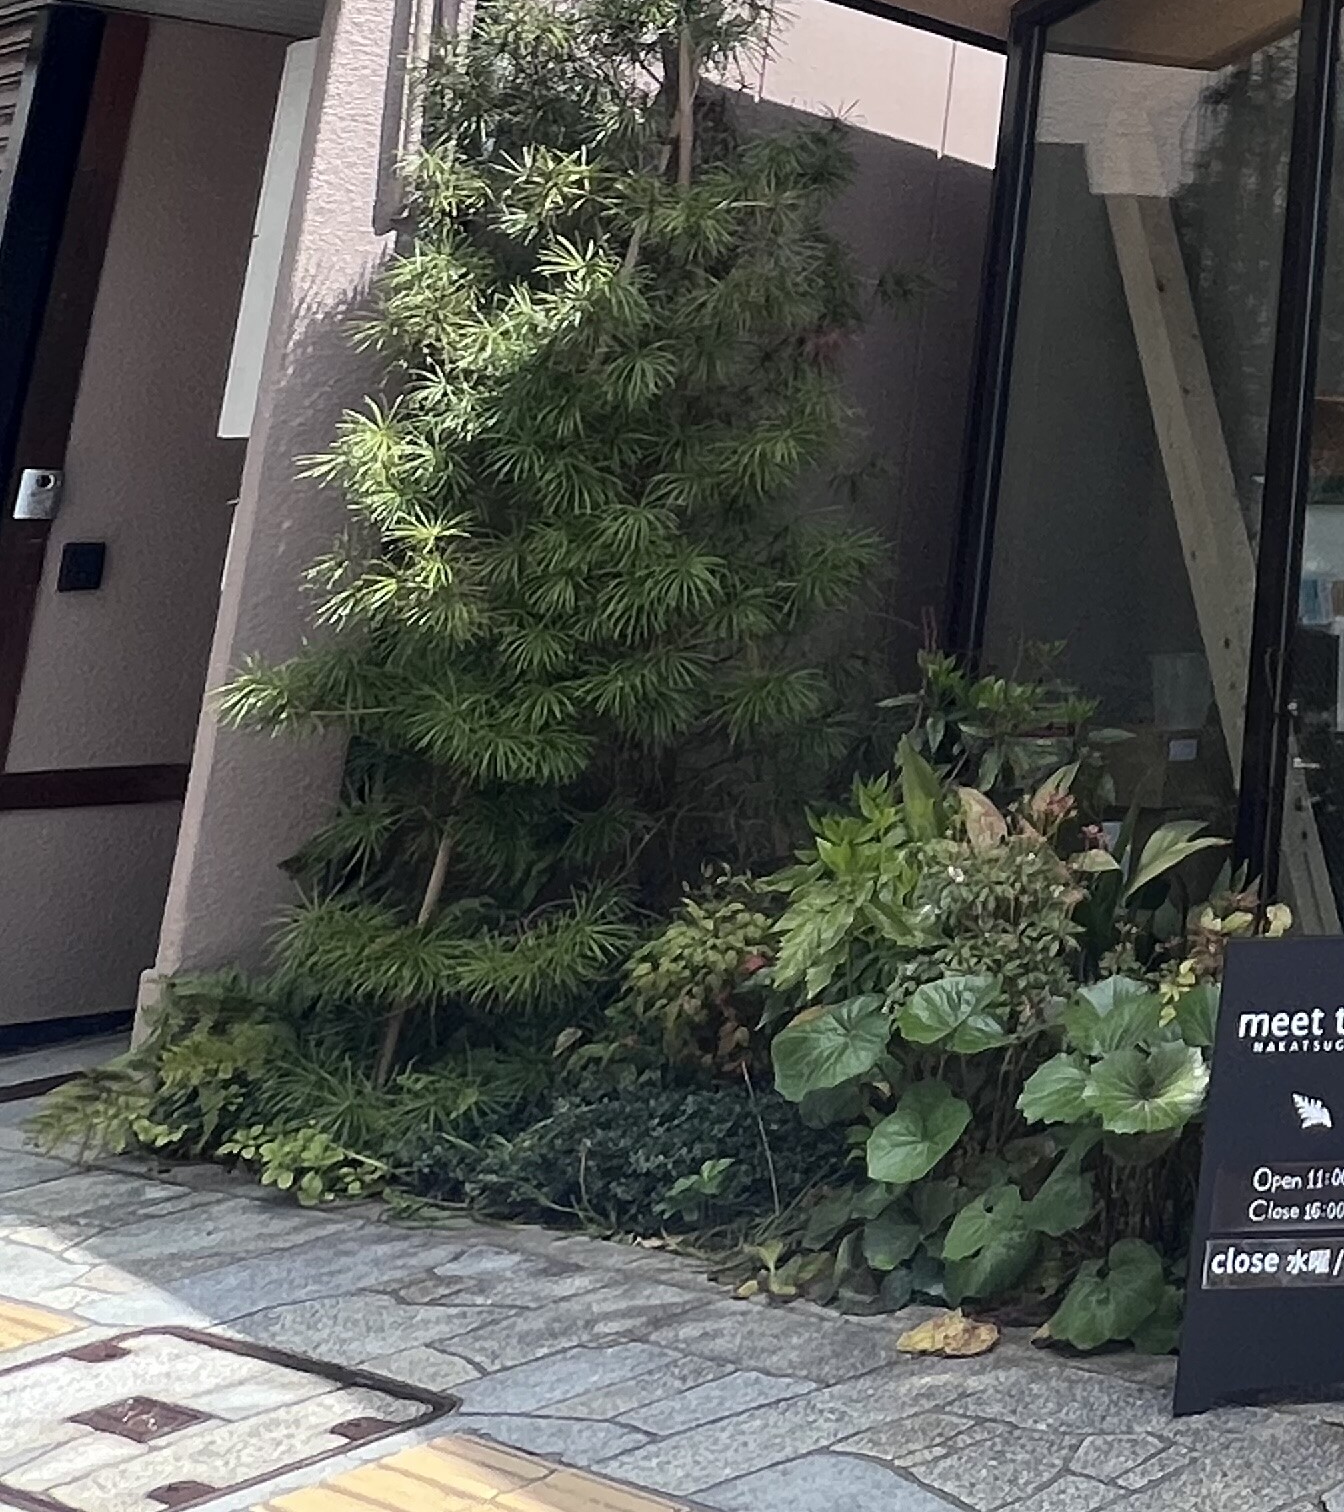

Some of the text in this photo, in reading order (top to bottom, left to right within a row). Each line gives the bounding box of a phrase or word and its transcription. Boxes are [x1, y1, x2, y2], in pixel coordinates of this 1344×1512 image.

[1238, 1008, 1325, 1038] meet
[1252, 1166, 1302, 1193] Open
[1248, 1199, 1300, 1222] Close
[1211, 1246, 1280, 1274] close
